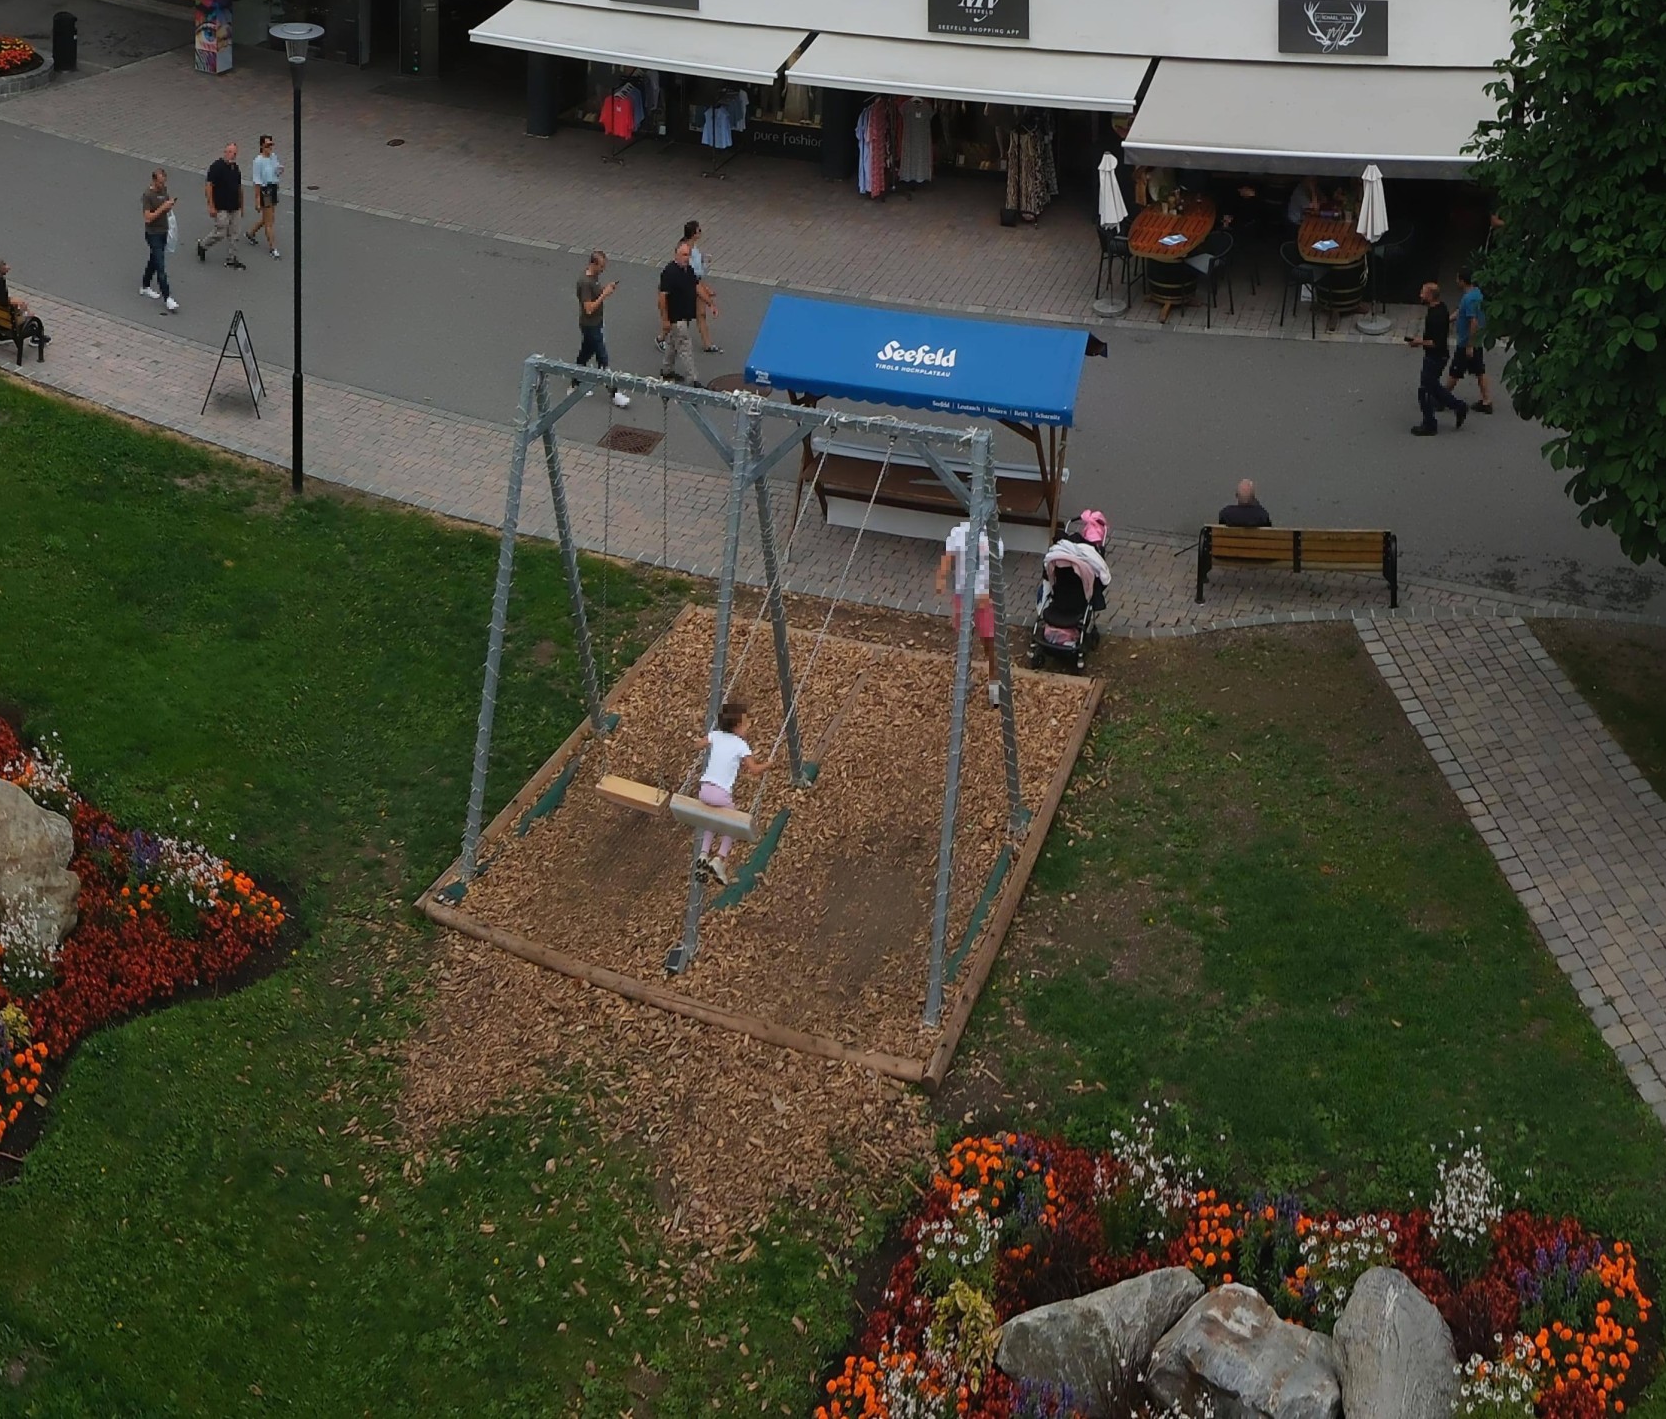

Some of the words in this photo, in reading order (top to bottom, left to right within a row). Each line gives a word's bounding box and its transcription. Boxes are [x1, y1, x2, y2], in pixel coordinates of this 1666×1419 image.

[969, 26, 1004, 34] SHOPPING
[753, 131, 780, 141] pure
[877, 340, 956, 368] Seefeld
[875, 363, 899, 372] TIROLS
[901, 366, 951, 378] HOCHPLATEAU
